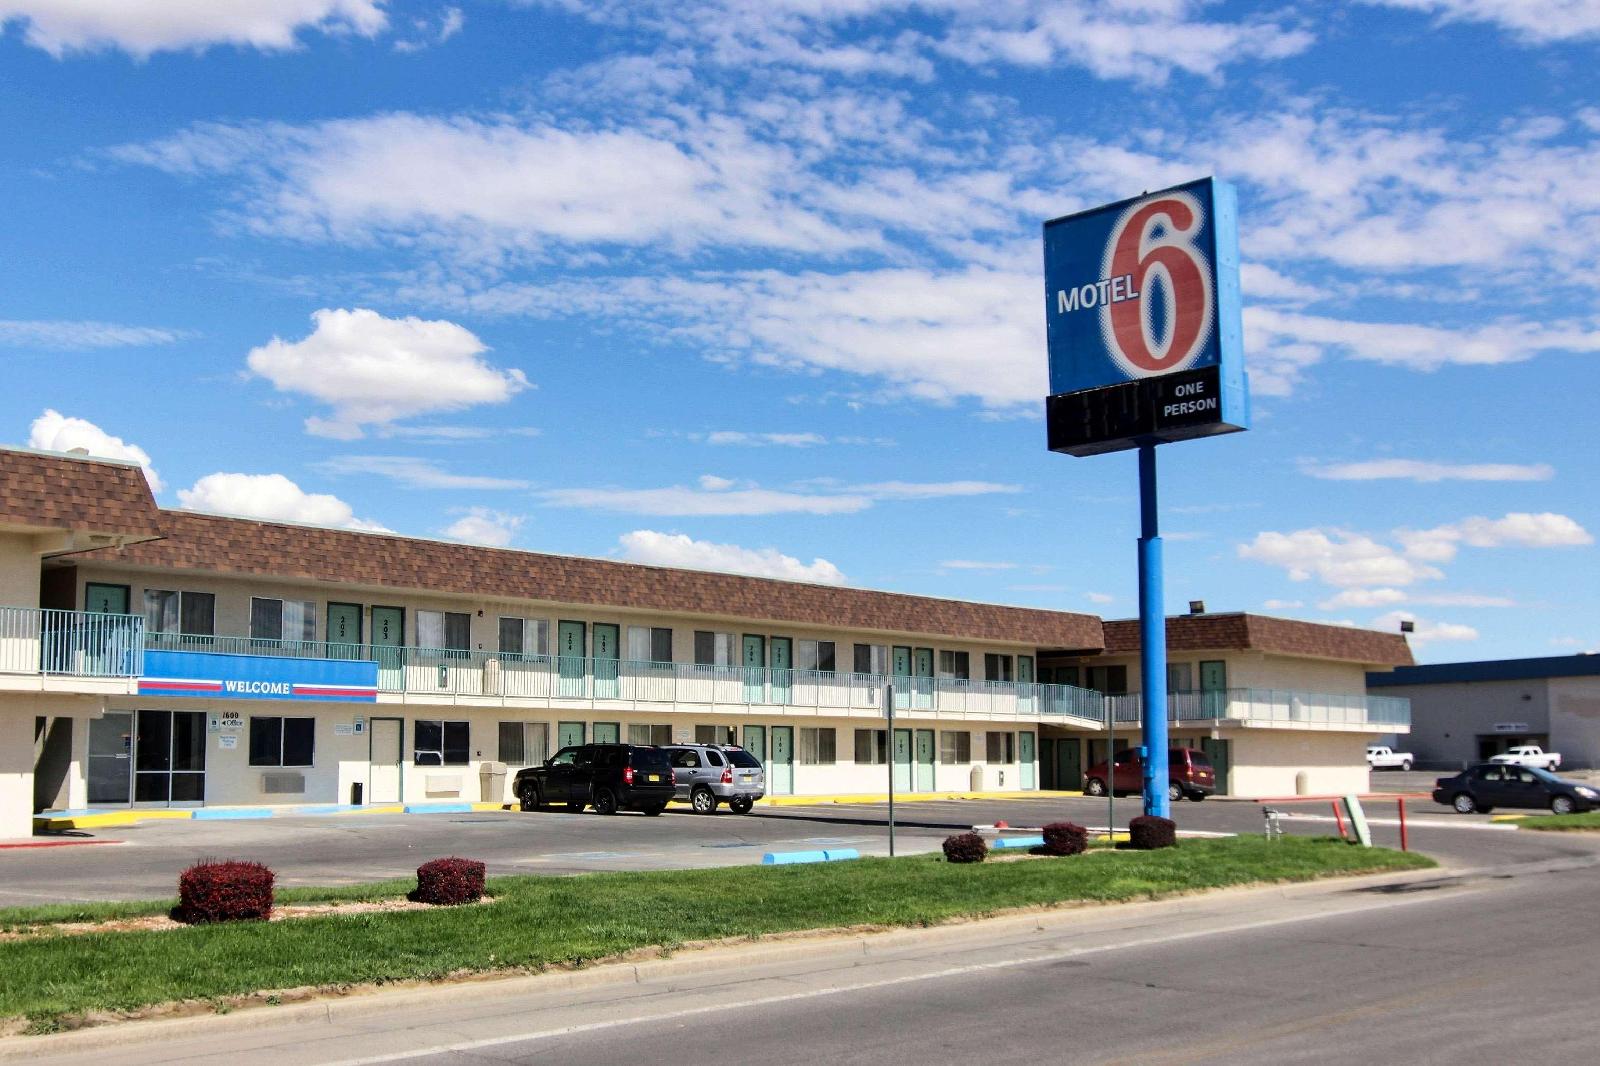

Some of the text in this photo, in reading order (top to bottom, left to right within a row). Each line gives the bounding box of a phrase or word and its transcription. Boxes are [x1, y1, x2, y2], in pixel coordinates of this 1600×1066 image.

[1057, 195, 1208, 374] MOTEL 6
[1174, 381, 1205, 398] ONE
[1163, 398, 1217, 417] PERSON
[225, 680, 290, 695] WELCOME
[222, 711, 239, 719] 1600
[226, 719, 244, 727] Office
